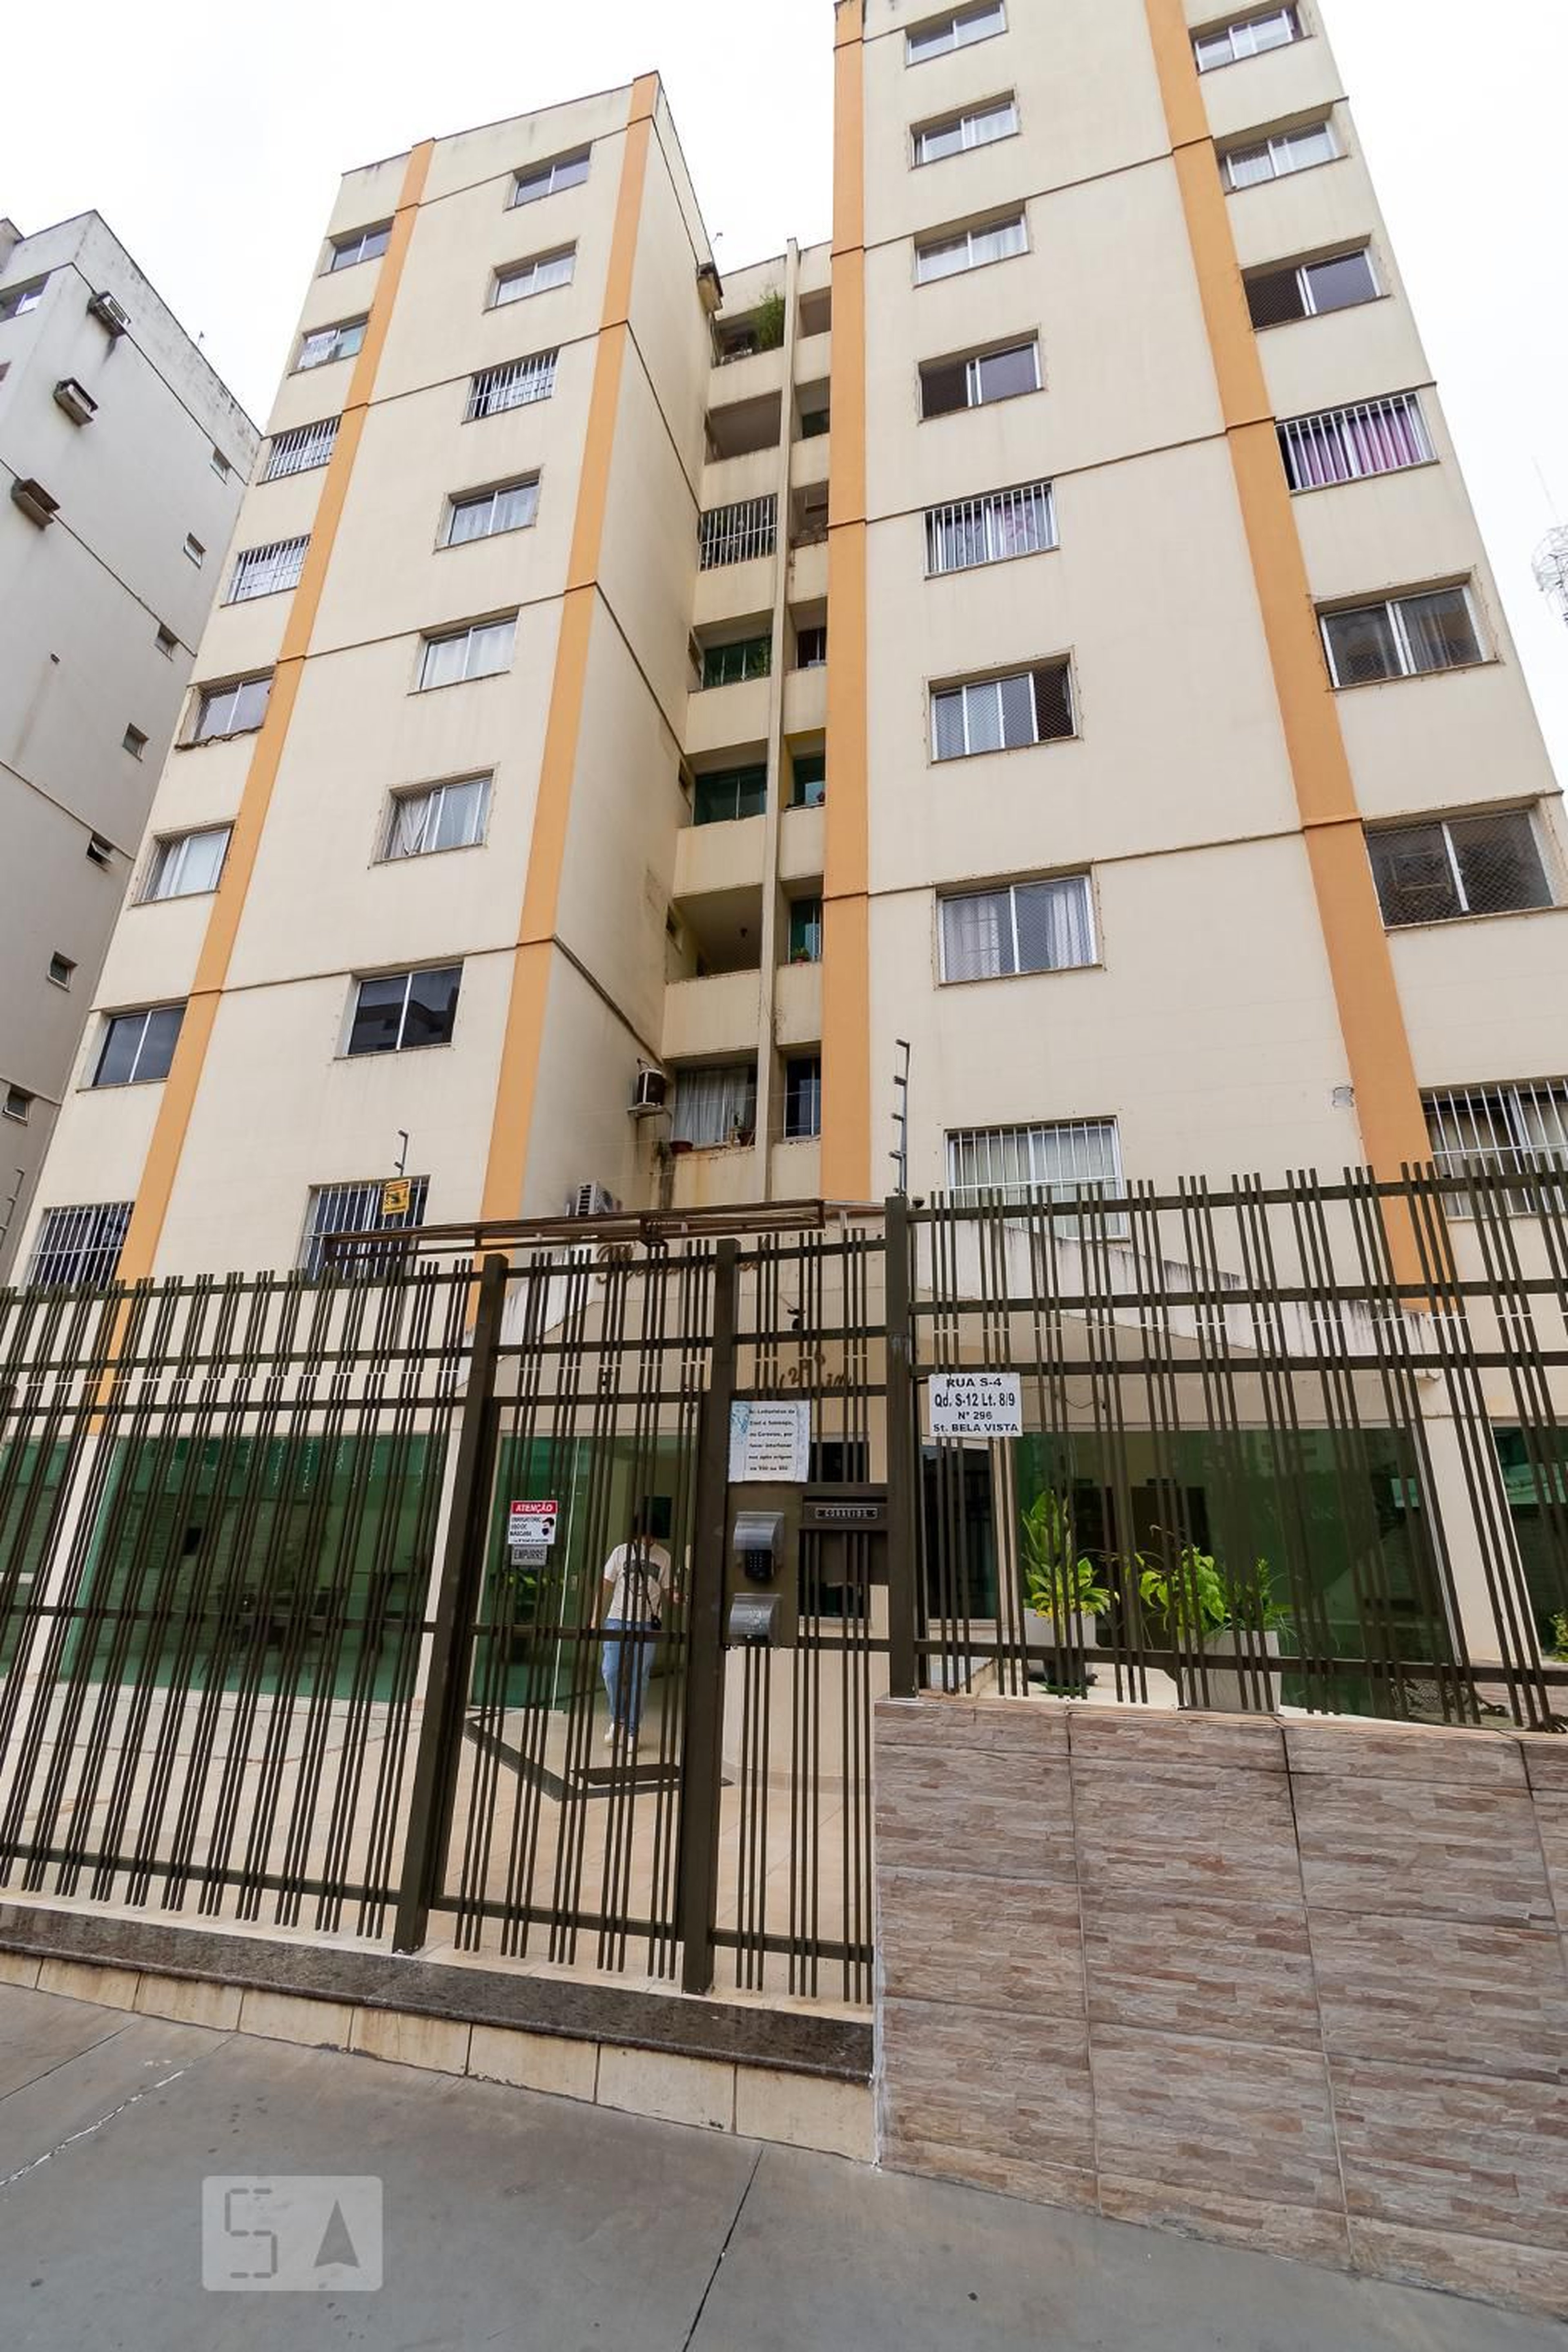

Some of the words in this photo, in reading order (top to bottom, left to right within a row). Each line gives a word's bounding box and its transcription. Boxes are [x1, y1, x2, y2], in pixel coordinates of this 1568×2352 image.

[947, 1378, 975, 1387] RUA
[980, 1378, 1002, 1387] S-4
[935, 1394, 952, 1407] Qd.
[955, 1393, 978, 1406] S-12
[982, 1393, 996, 1406] Lt.
[973, 1411, 992, 1419] 296
[952, 1423, 980, 1432] BELA
[516, 1503, 553, 1513] ATENÇÃO
